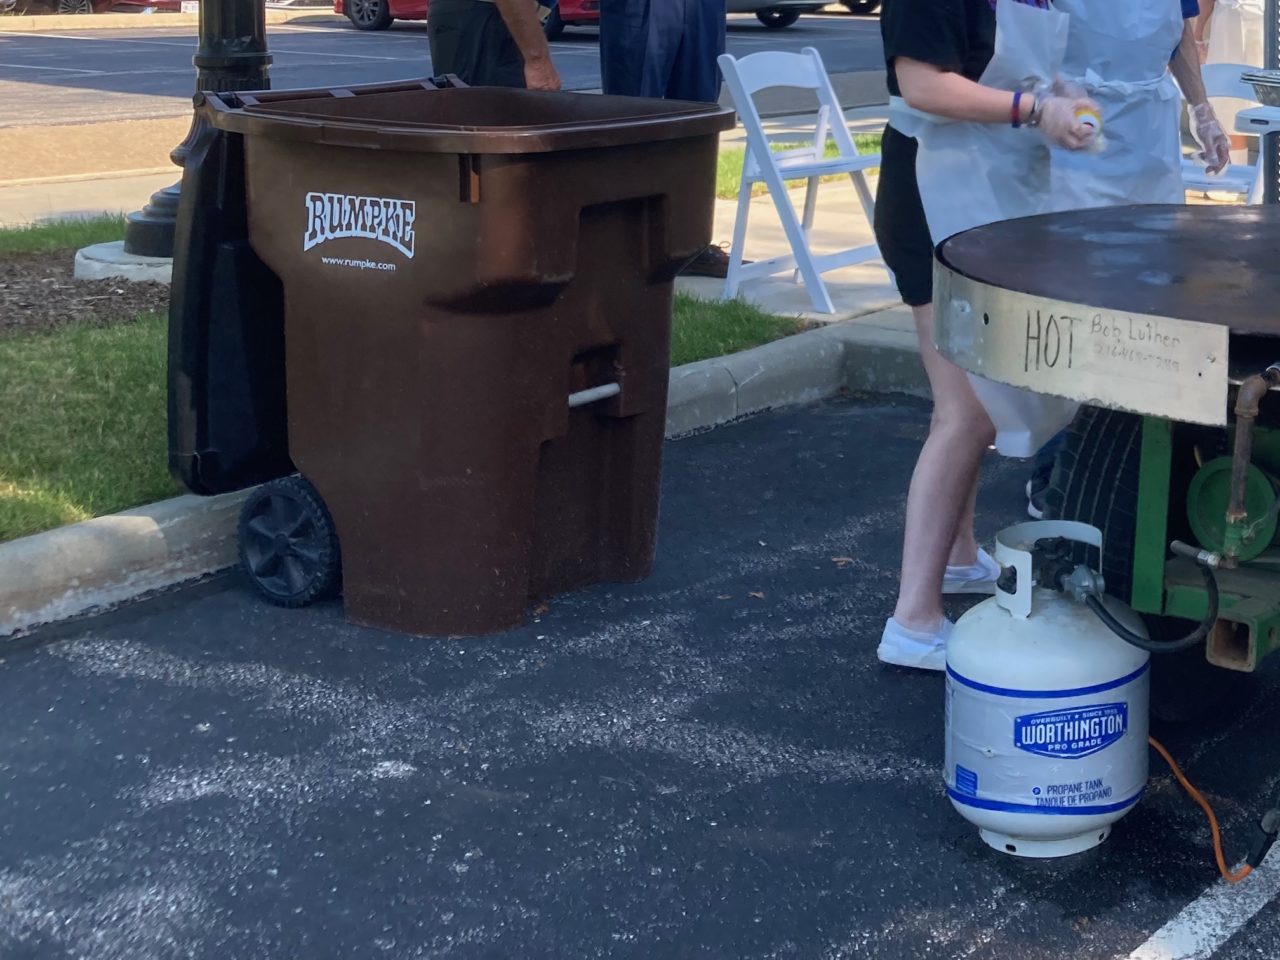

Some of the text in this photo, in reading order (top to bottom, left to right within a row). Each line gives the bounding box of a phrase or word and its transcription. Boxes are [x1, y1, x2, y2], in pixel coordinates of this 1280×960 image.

[304, 192, 415, 259] RUMPKE
[321, 256, 396, 271] www.rumpke.com
[1024, 309, 1083, 373] HOT
[1128, 316, 1183, 348] Luther
[1031, 714, 1071, 725] OVERBUILT
[1082, 710, 1102, 719] SINCE
[1021, 714, 1123, 745] WORTHINGTON
[1047, 737, 1102, 751] PRO GRADE
[1047, 778, 1104, 795] PROPANE TANK
[1067, 795, 1078, 806] DE
[1079, 786, 1112, 804] PROPANO
